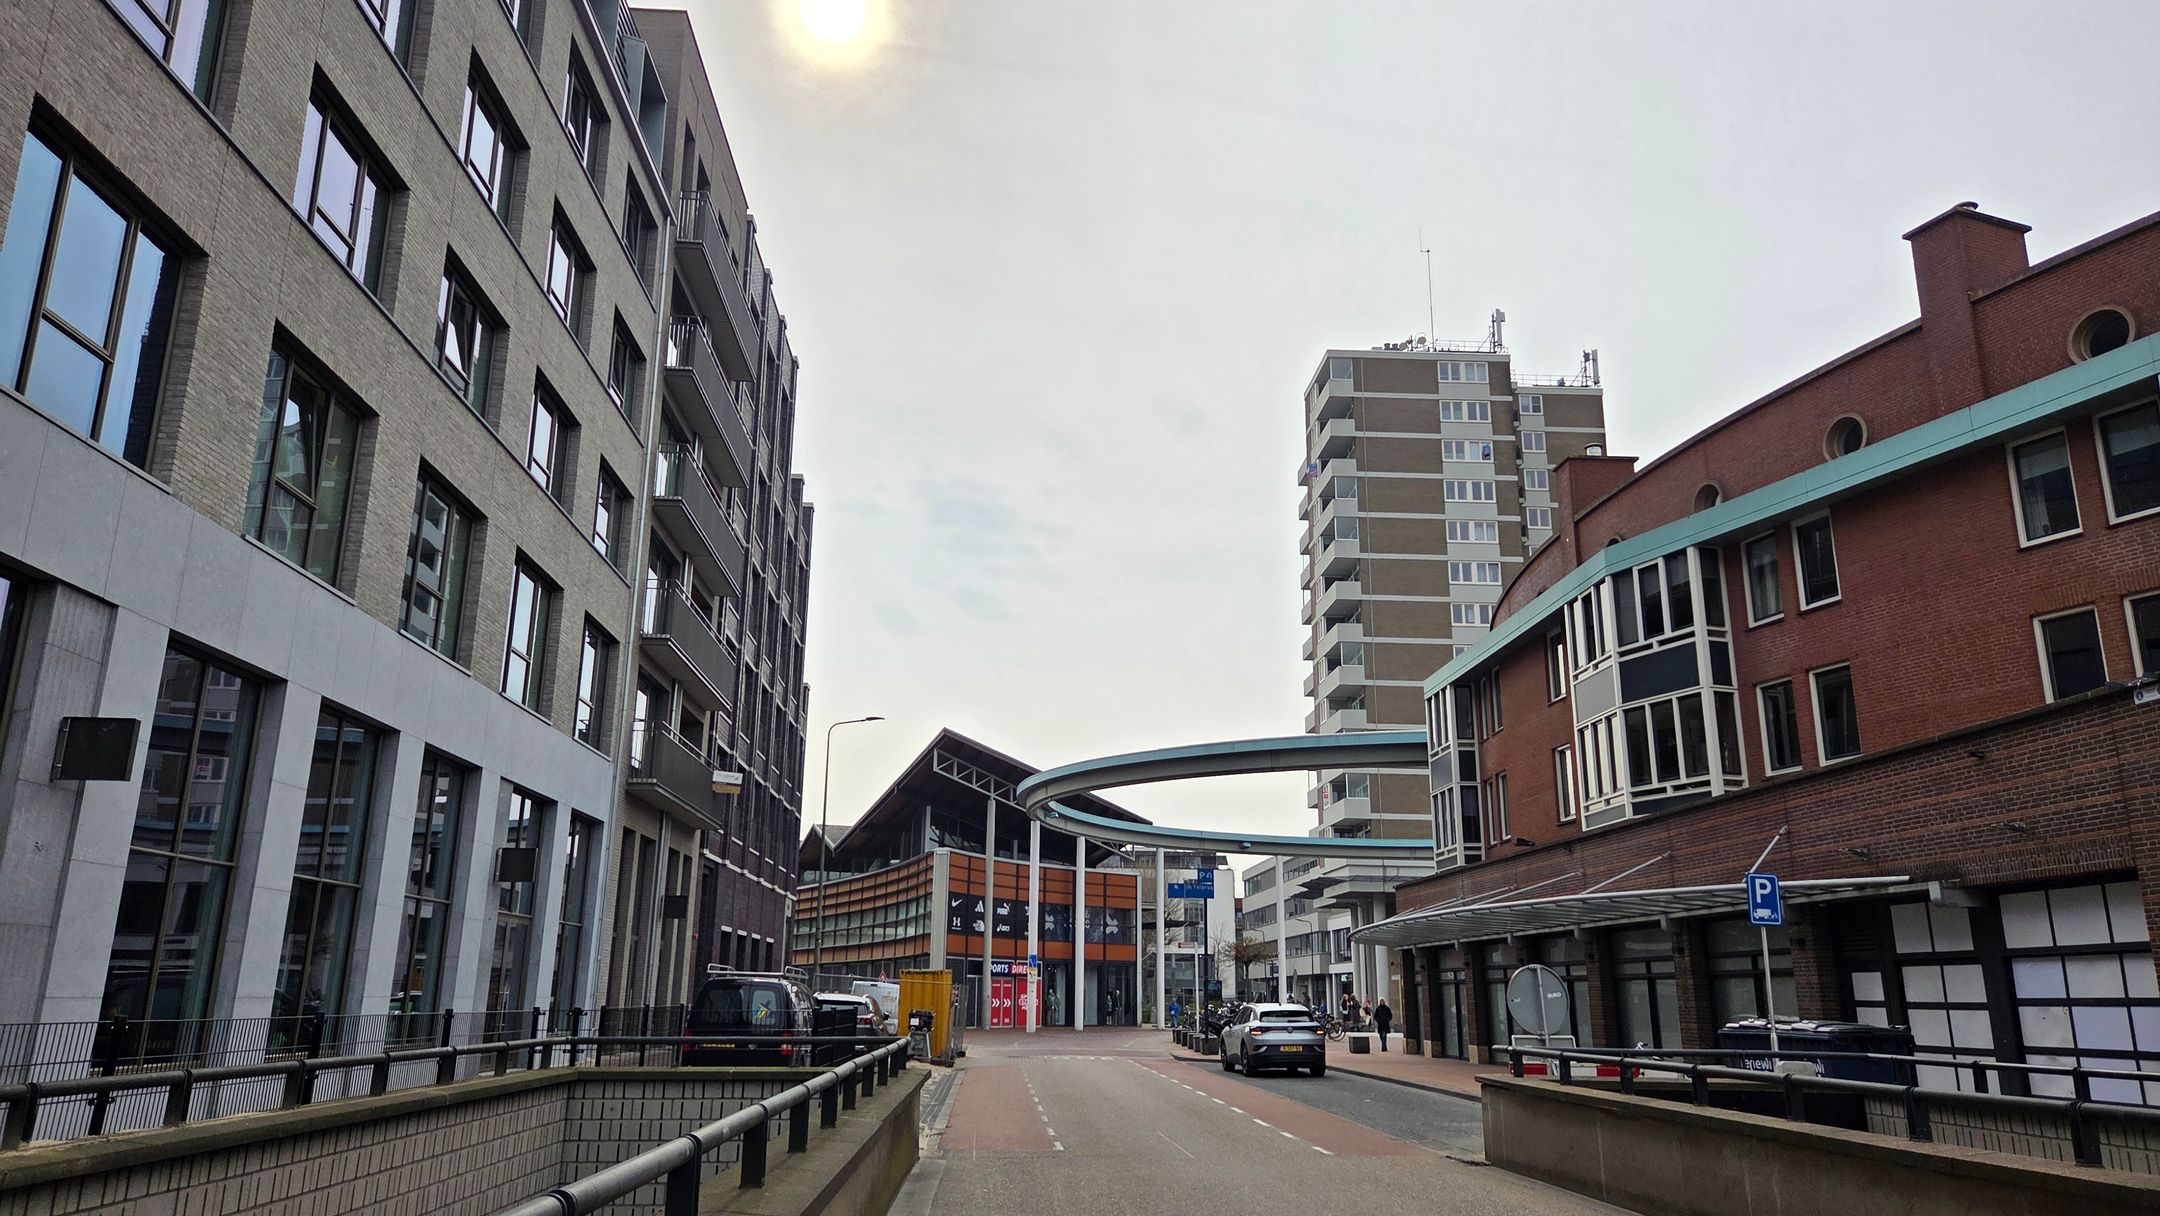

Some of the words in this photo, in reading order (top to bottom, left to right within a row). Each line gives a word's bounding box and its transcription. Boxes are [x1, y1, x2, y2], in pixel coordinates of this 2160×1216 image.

[1755, 878, 1772, 903] P
[990, 964, 1008, 973] PORTS
[1012, 965, 1028, 974] DIRE
